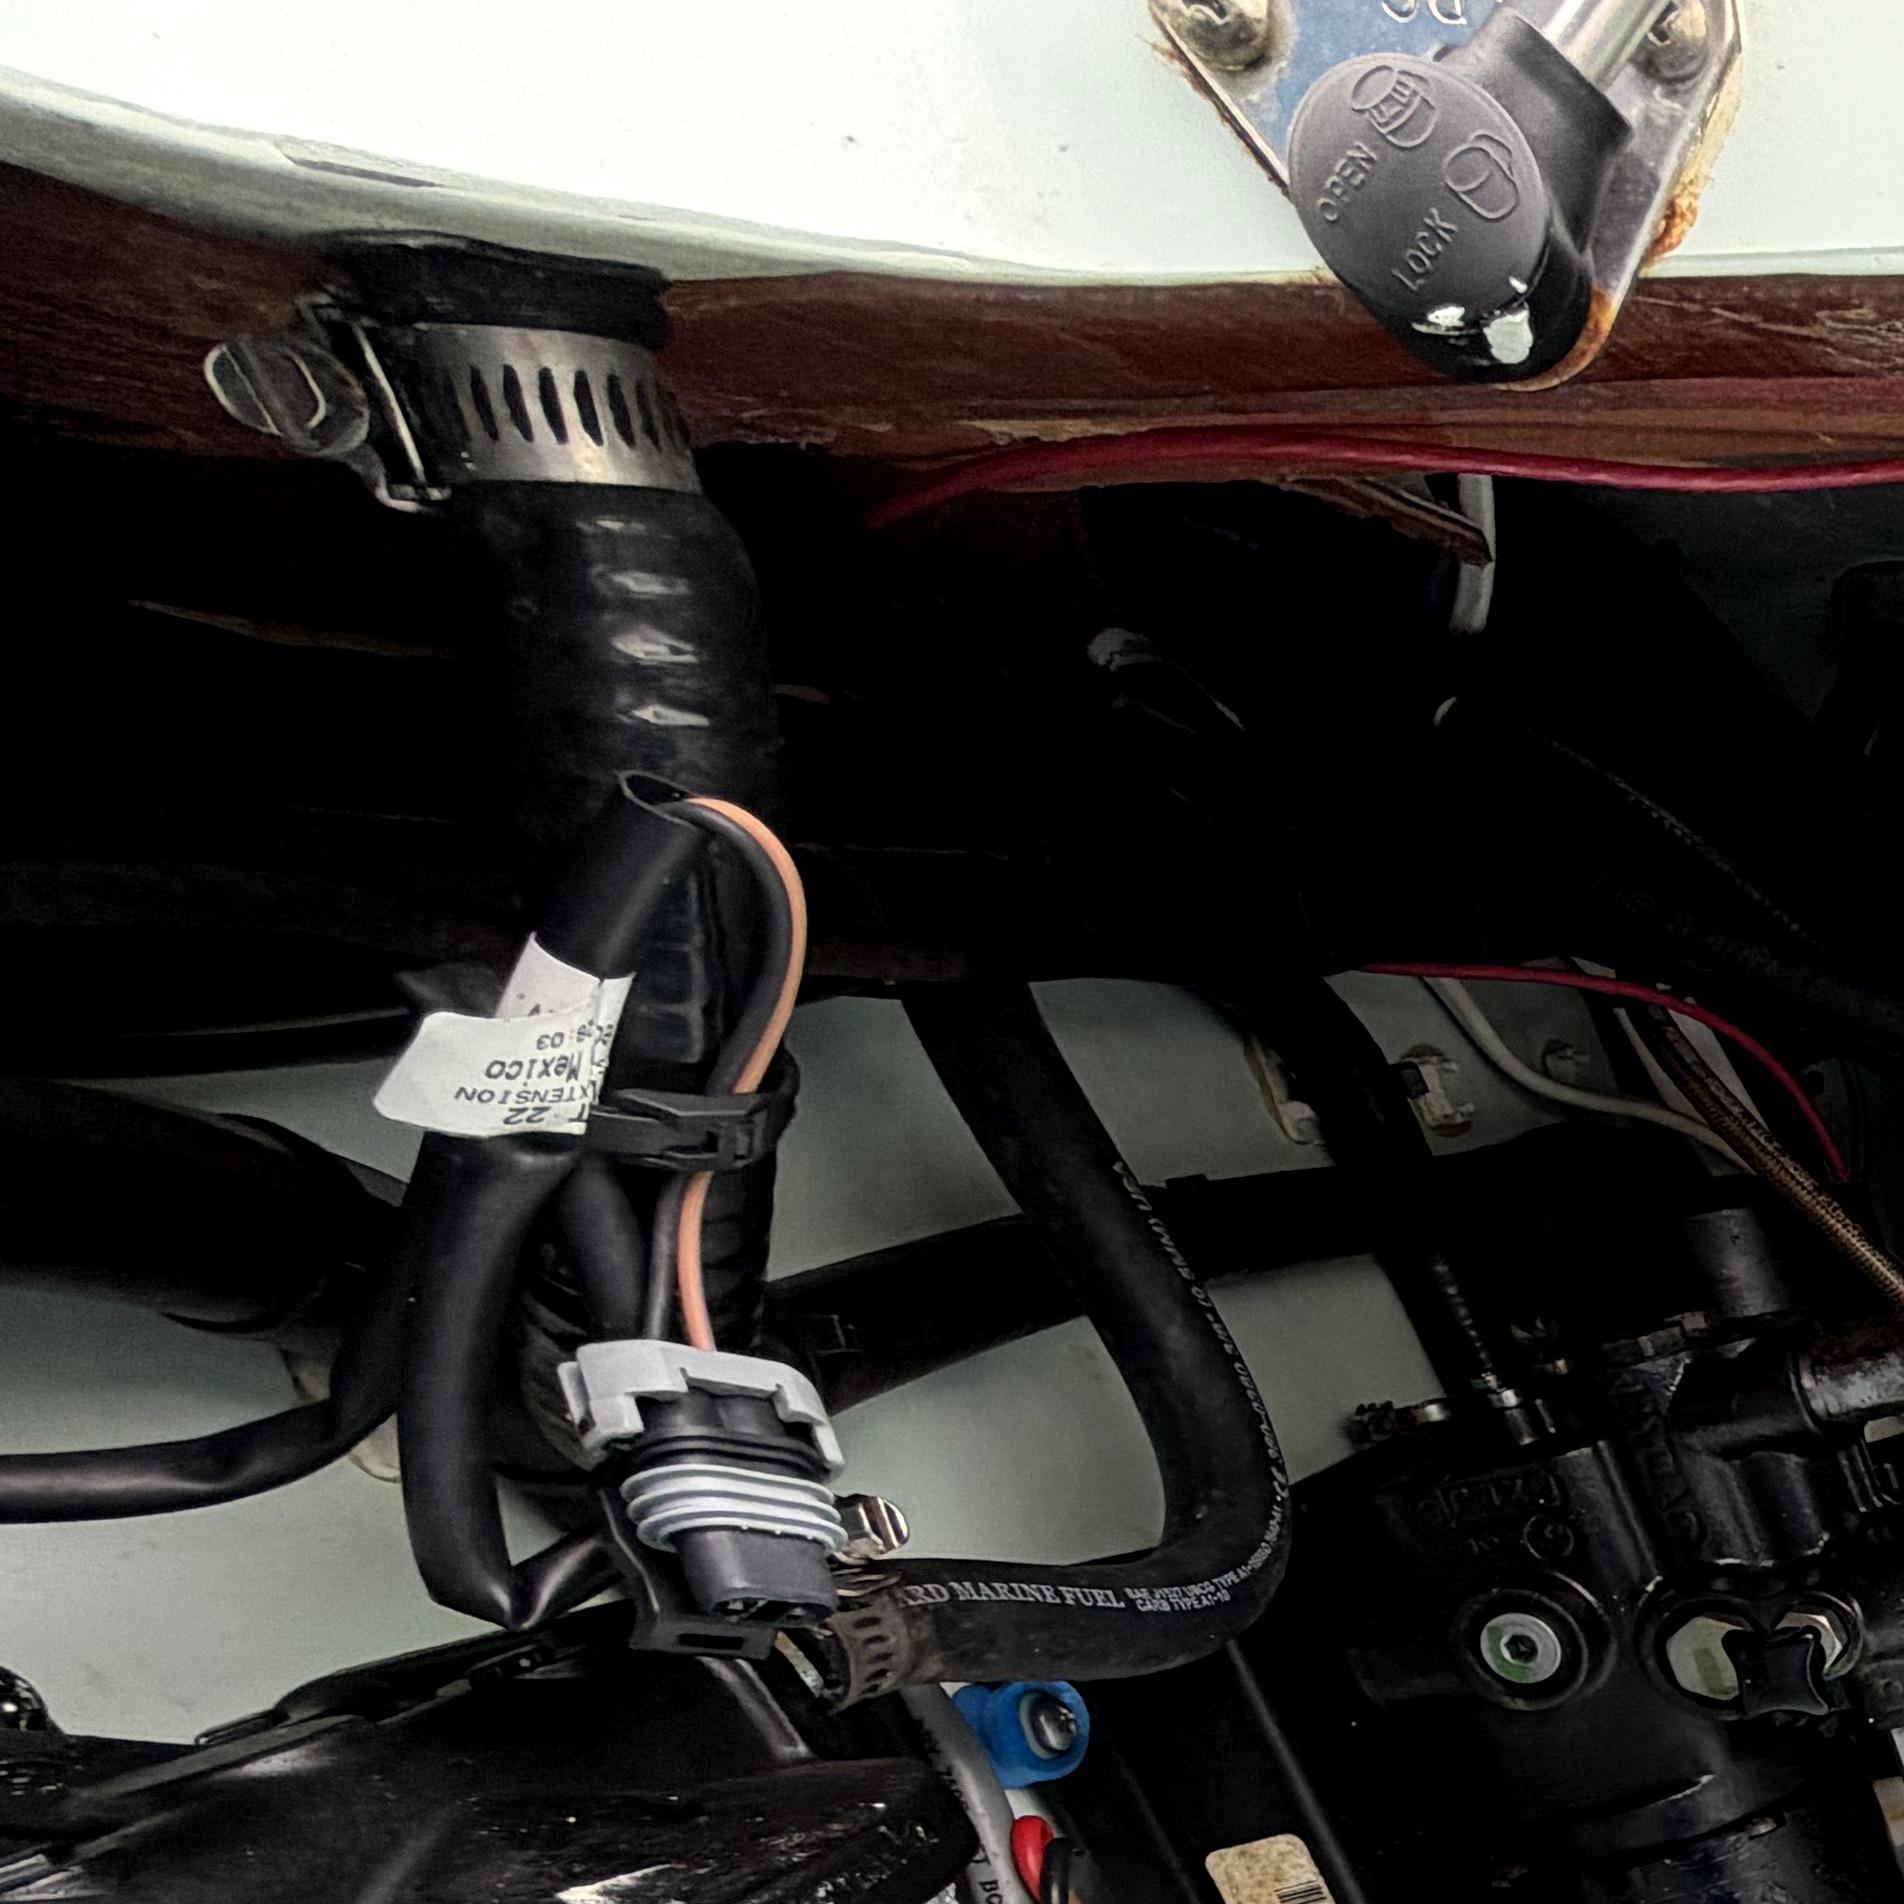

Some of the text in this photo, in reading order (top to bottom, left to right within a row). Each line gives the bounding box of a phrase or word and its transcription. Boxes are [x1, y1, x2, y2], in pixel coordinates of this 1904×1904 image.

[1316, 140, 1378, 224] OPEN
[1390, 206, 1460, 291] LOCK
[485, 1050, 581, 1086] Mexico
[454, 1080, 600, 1106] XTENSION
[503, 1106, 550, 1125] 22
[951, 1579, 1064, 1608] MARINE
[1059, 1583, 1126, 1612] FUEL
